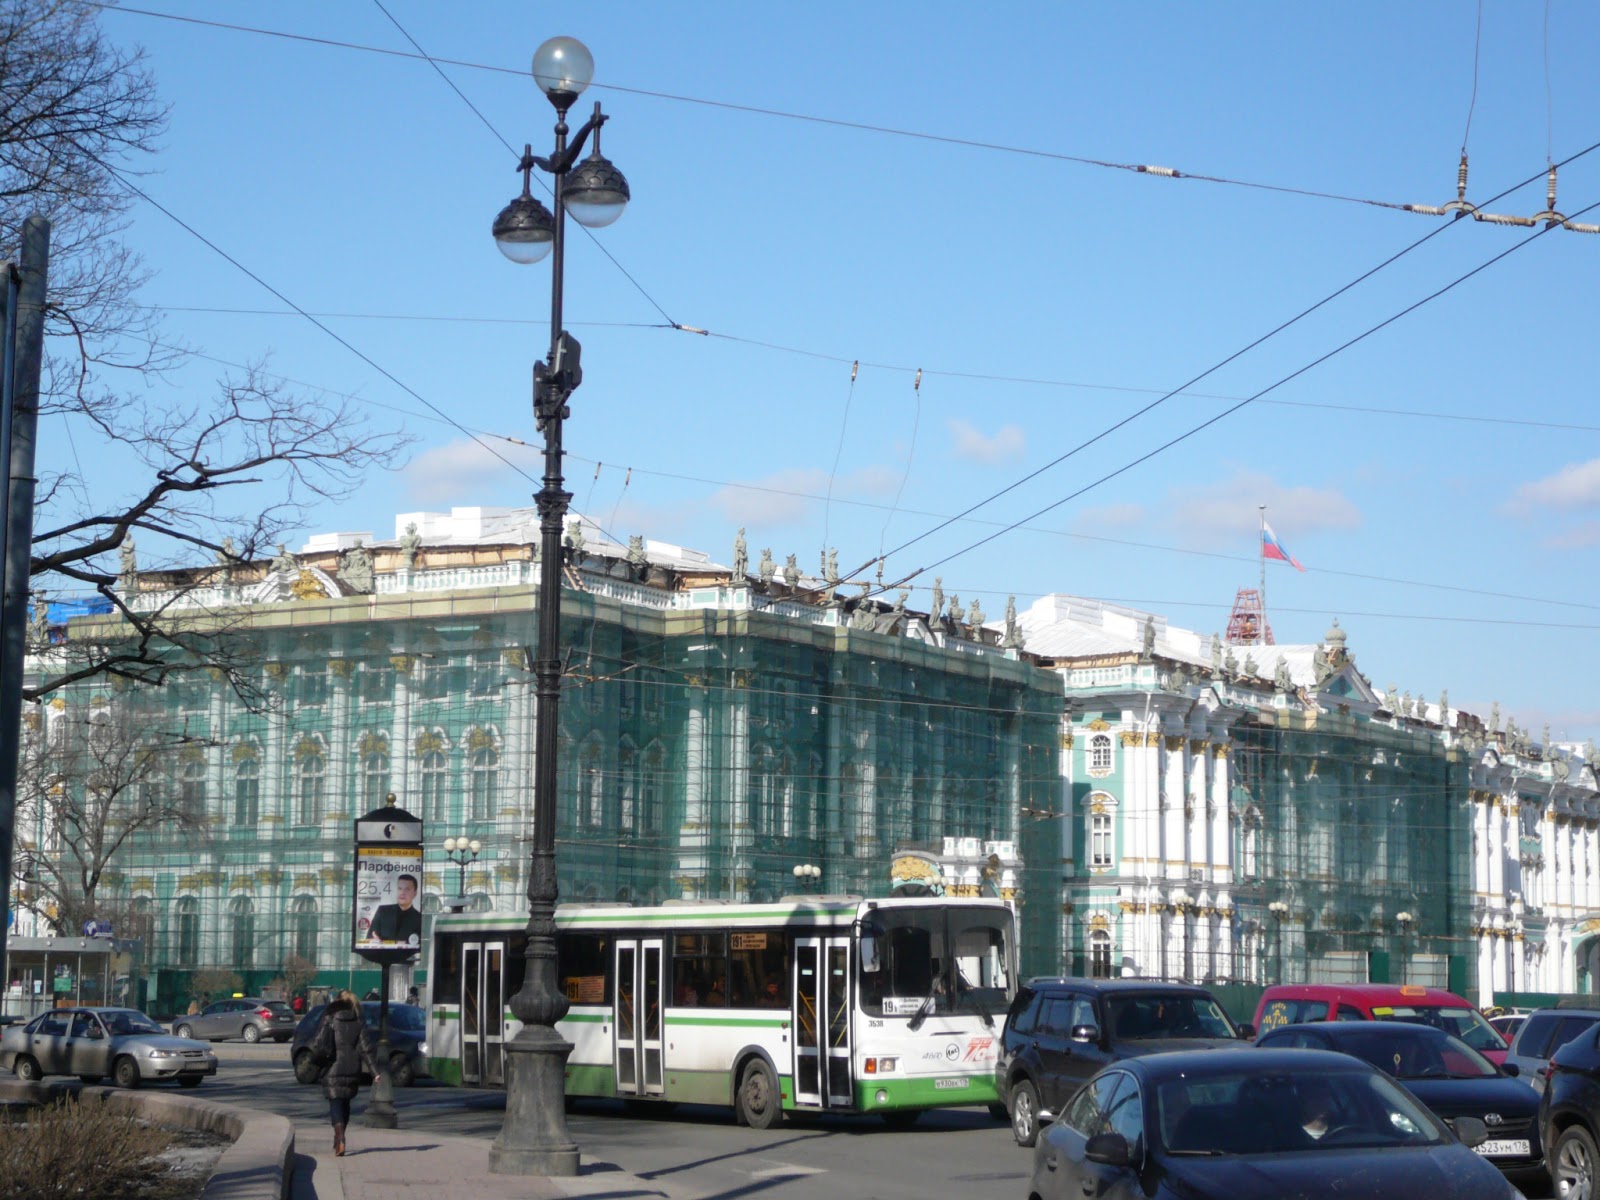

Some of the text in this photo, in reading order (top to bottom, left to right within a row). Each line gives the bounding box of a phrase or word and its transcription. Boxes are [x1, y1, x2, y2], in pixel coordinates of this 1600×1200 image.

[358, 860, 422, 874] Парфёнов
[358, 881, 392, 895] 25.4
[732, 935, 743, 948] 191
[868, 1020, 884, 1028] 3538
[1513, 1141, 1527, 1150] 178
